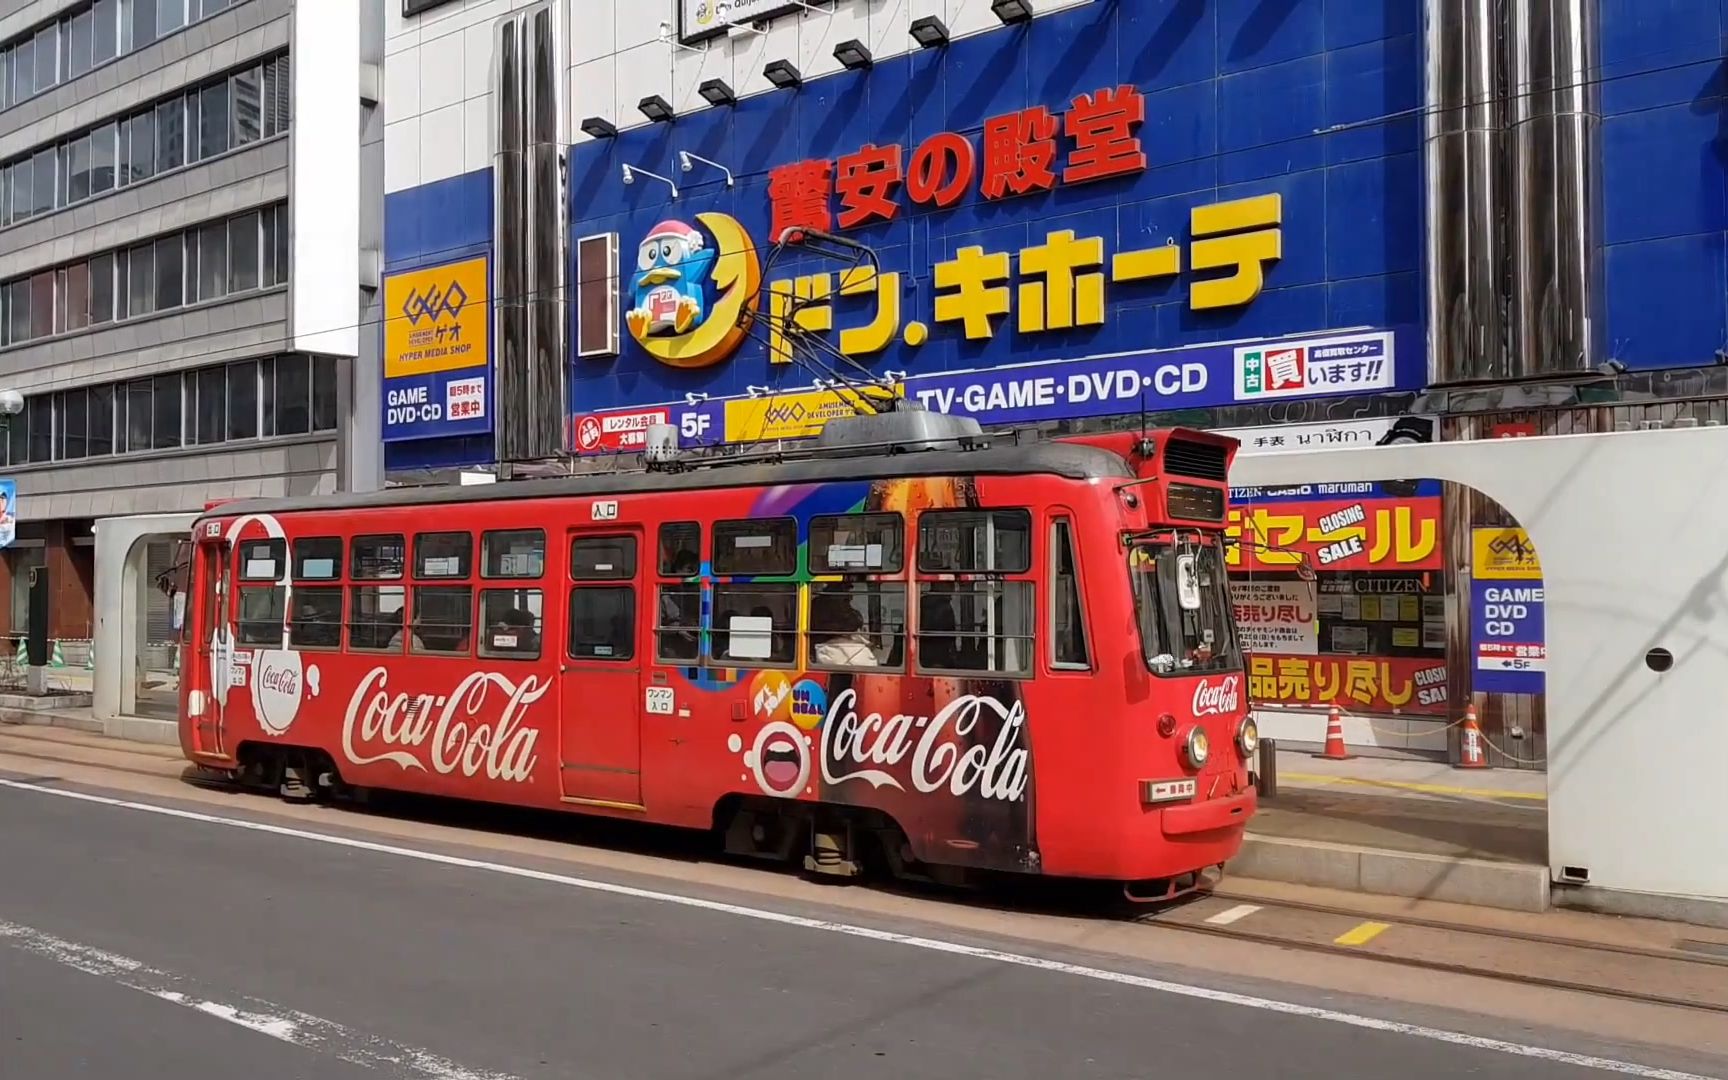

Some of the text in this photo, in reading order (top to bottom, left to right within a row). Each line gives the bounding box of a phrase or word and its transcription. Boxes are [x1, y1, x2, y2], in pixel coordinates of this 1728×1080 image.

[767, 84, 1148, 245] 驚安の殿堂
[435, 322, 462, 344] ゲオ
[399, 343, 472, 362] HYPER MEDIA SHOP
[1246, 357, 1260, 388] 中古
[388, 386, 428, 407] GAME
[450, 399, 481, 417] 営業中
[681, 412, 712, 438] 5F
[1253, 436, 1285, 447] 手表
[1318, 482, 1373, 495] maruman
[593, 503, 616, 517] 入口
[1319, 504, 1365, 533] CLOSING
[1317, 536, 1363, 564] SALE
[1355, 578, 1431, 593] CITIZEN
[1485, 588, 1545, 602] GAME
[1485, 604, 1527, 619] DVD
[1485, 621, 1515, 635] CD
[1513, 659, 1531, 669] 5F
[648, 689, 672, 700] ワンマン
[651, 702, 668, 712] 入口
[343, 666, 553, 783] Coca-Cola
[820, 688, 1028, 802] Coca-Cola
